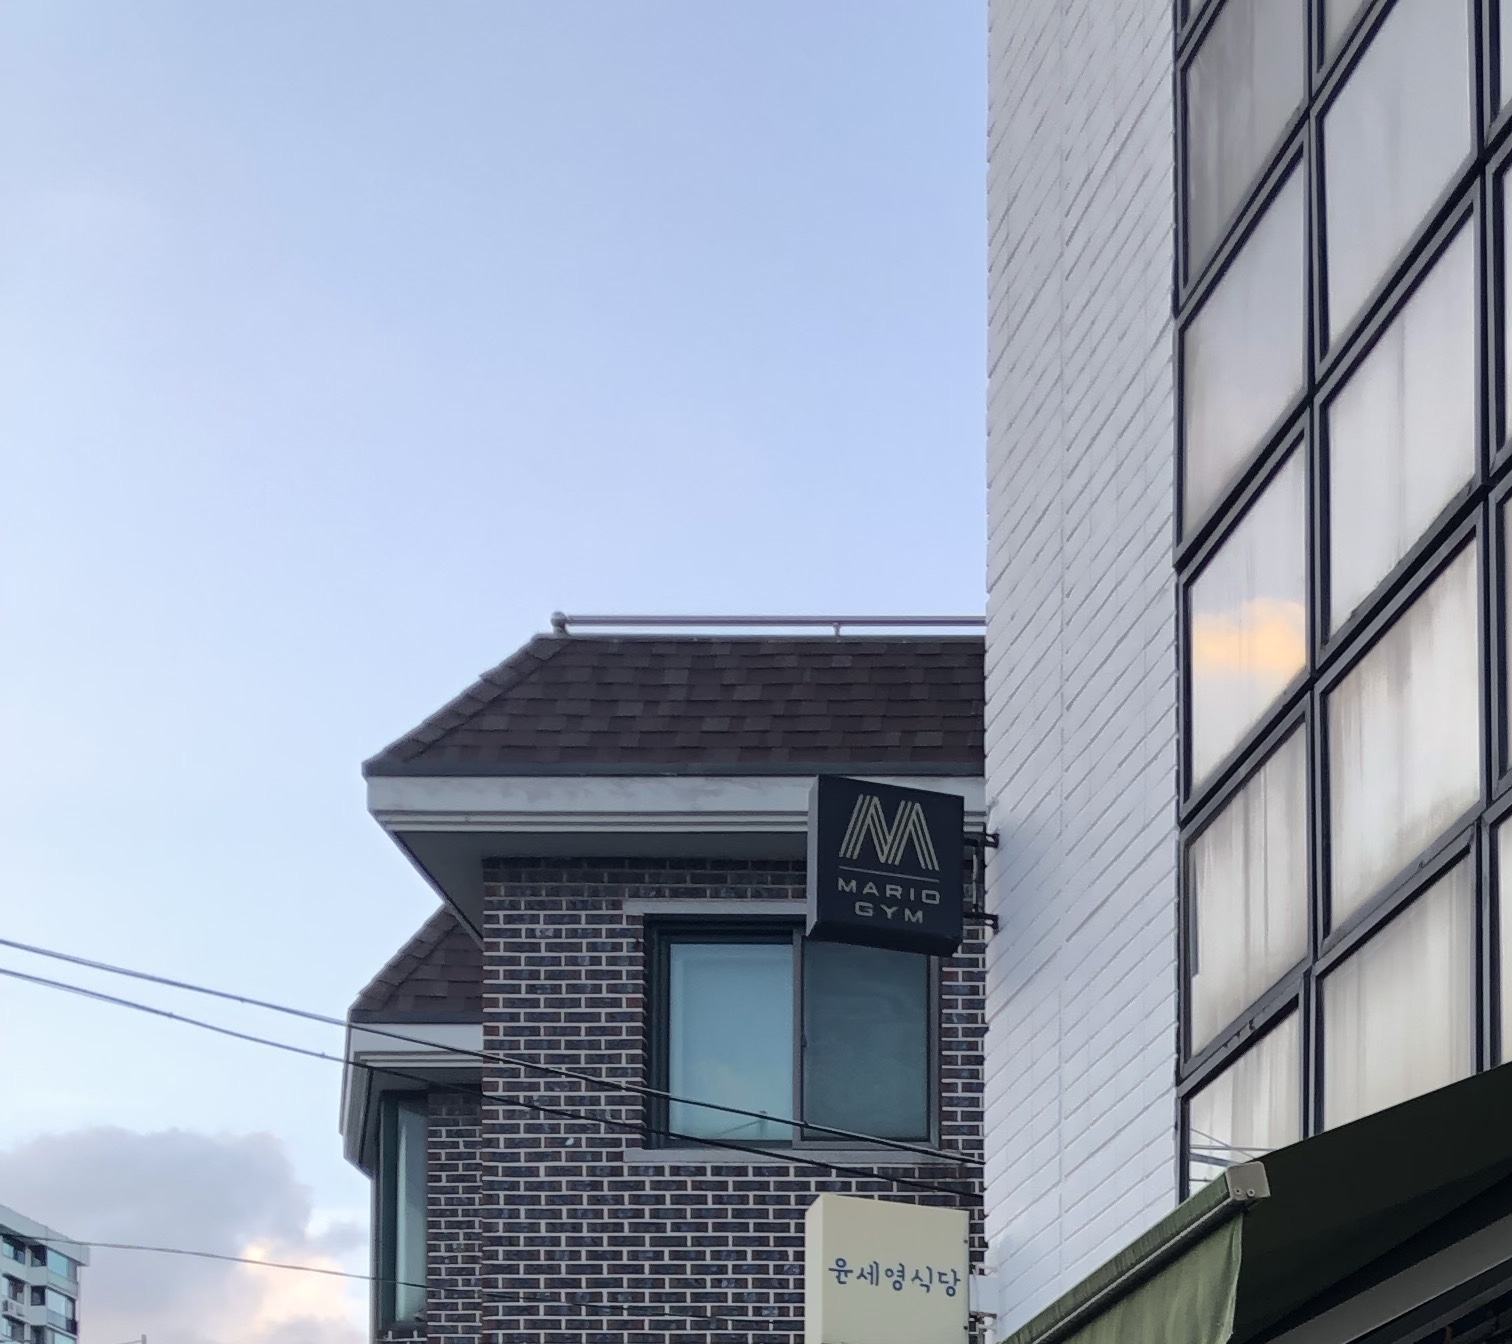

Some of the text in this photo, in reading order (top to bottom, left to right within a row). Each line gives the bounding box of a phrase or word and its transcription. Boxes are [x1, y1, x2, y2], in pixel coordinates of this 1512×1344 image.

[838, 877, 940, 905] MARIO
[854, 901, 923, 923] GYM
[828, 1257, 961, 1297] 윤세영식당
